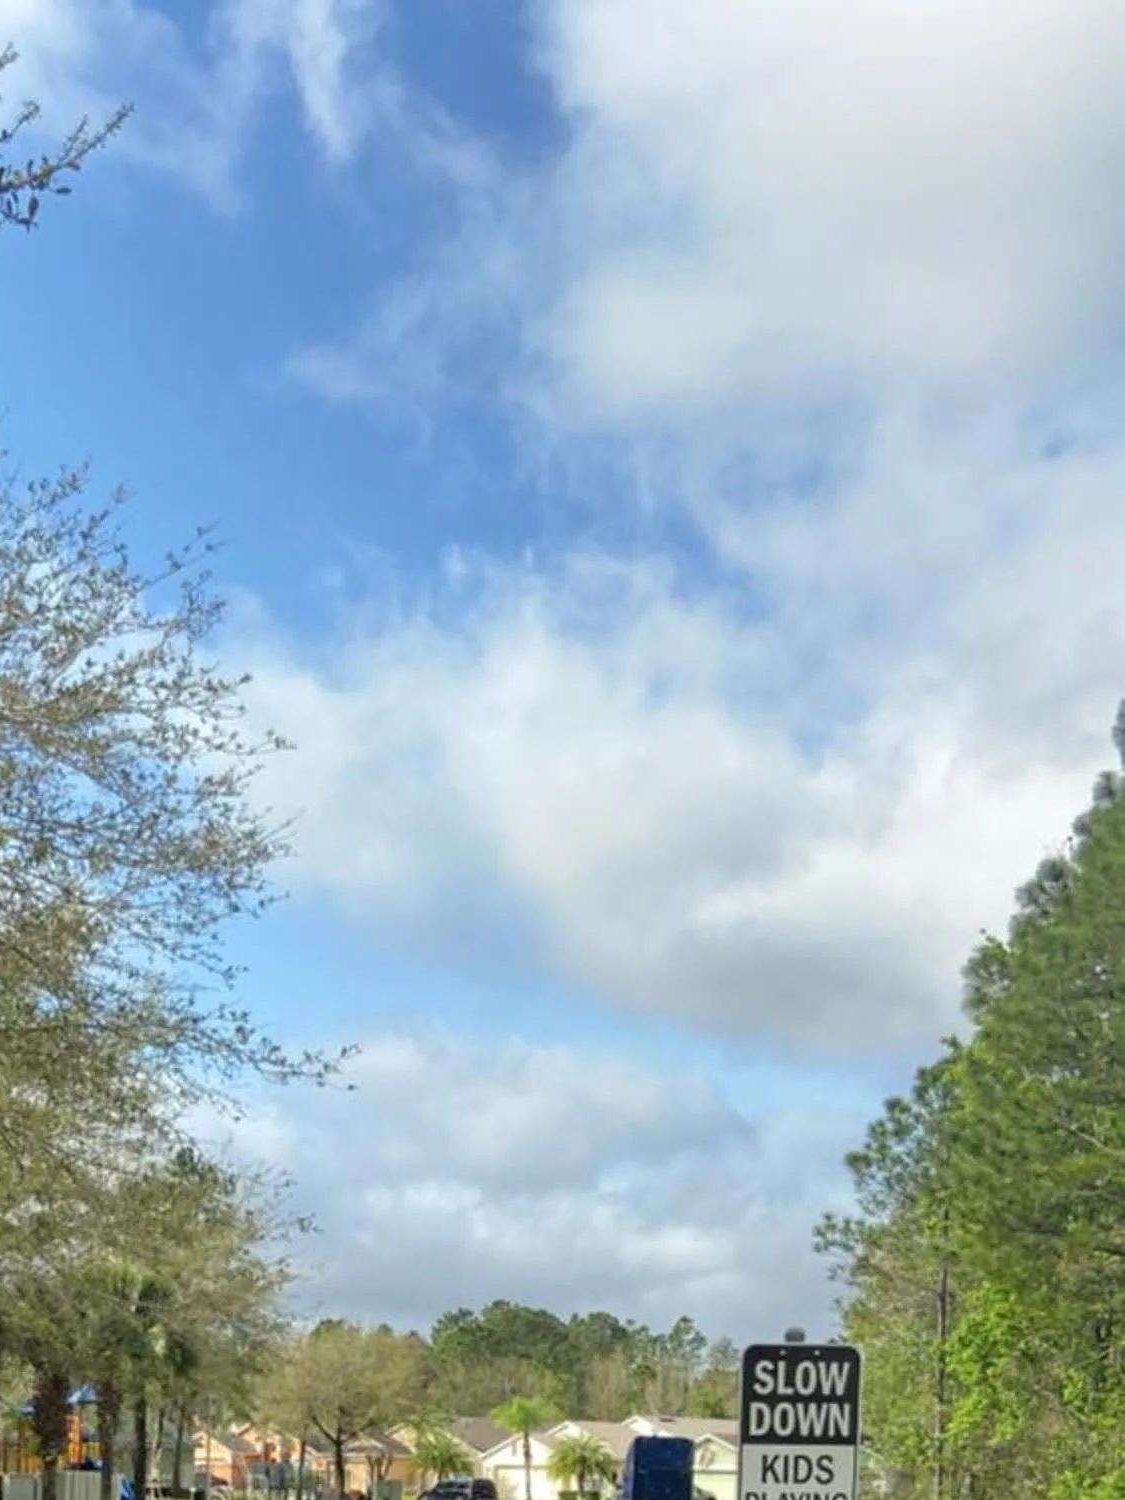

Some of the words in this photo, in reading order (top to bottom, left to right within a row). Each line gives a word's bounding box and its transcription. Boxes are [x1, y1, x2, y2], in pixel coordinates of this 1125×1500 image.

[753, 1360, 850, 1396] SLOW
[748, 1402, 850, 1438] DOWN
[761, 1454, 835, 1485] KIDS
